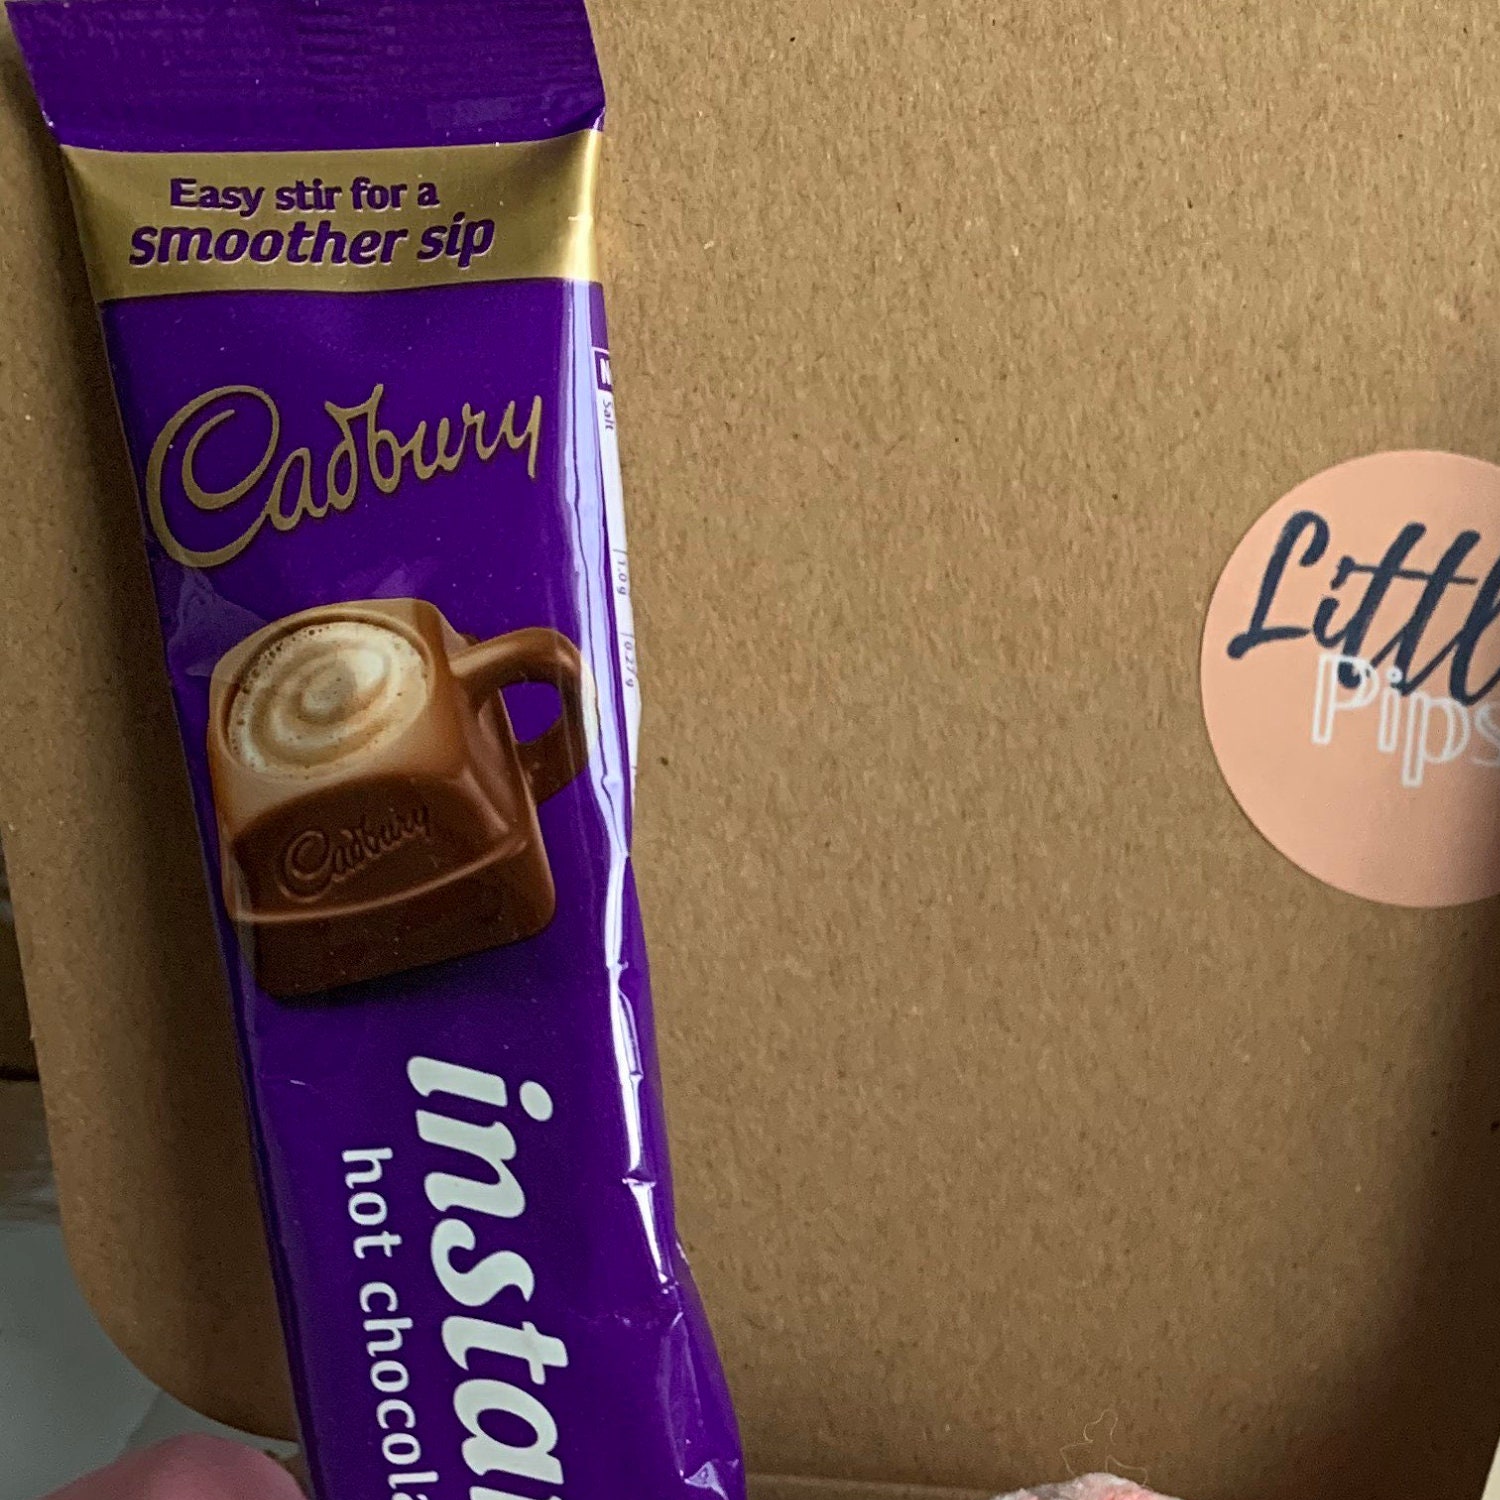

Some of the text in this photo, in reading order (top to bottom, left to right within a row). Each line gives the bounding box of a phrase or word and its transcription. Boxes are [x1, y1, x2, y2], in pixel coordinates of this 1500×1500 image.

[170, 176, 440, 217] Easy stir for a
[129, 211, 495, 269] smoother sip
[146, 383, 542, 568] Cadbury
[342, 1146, 402, 1260] hot
